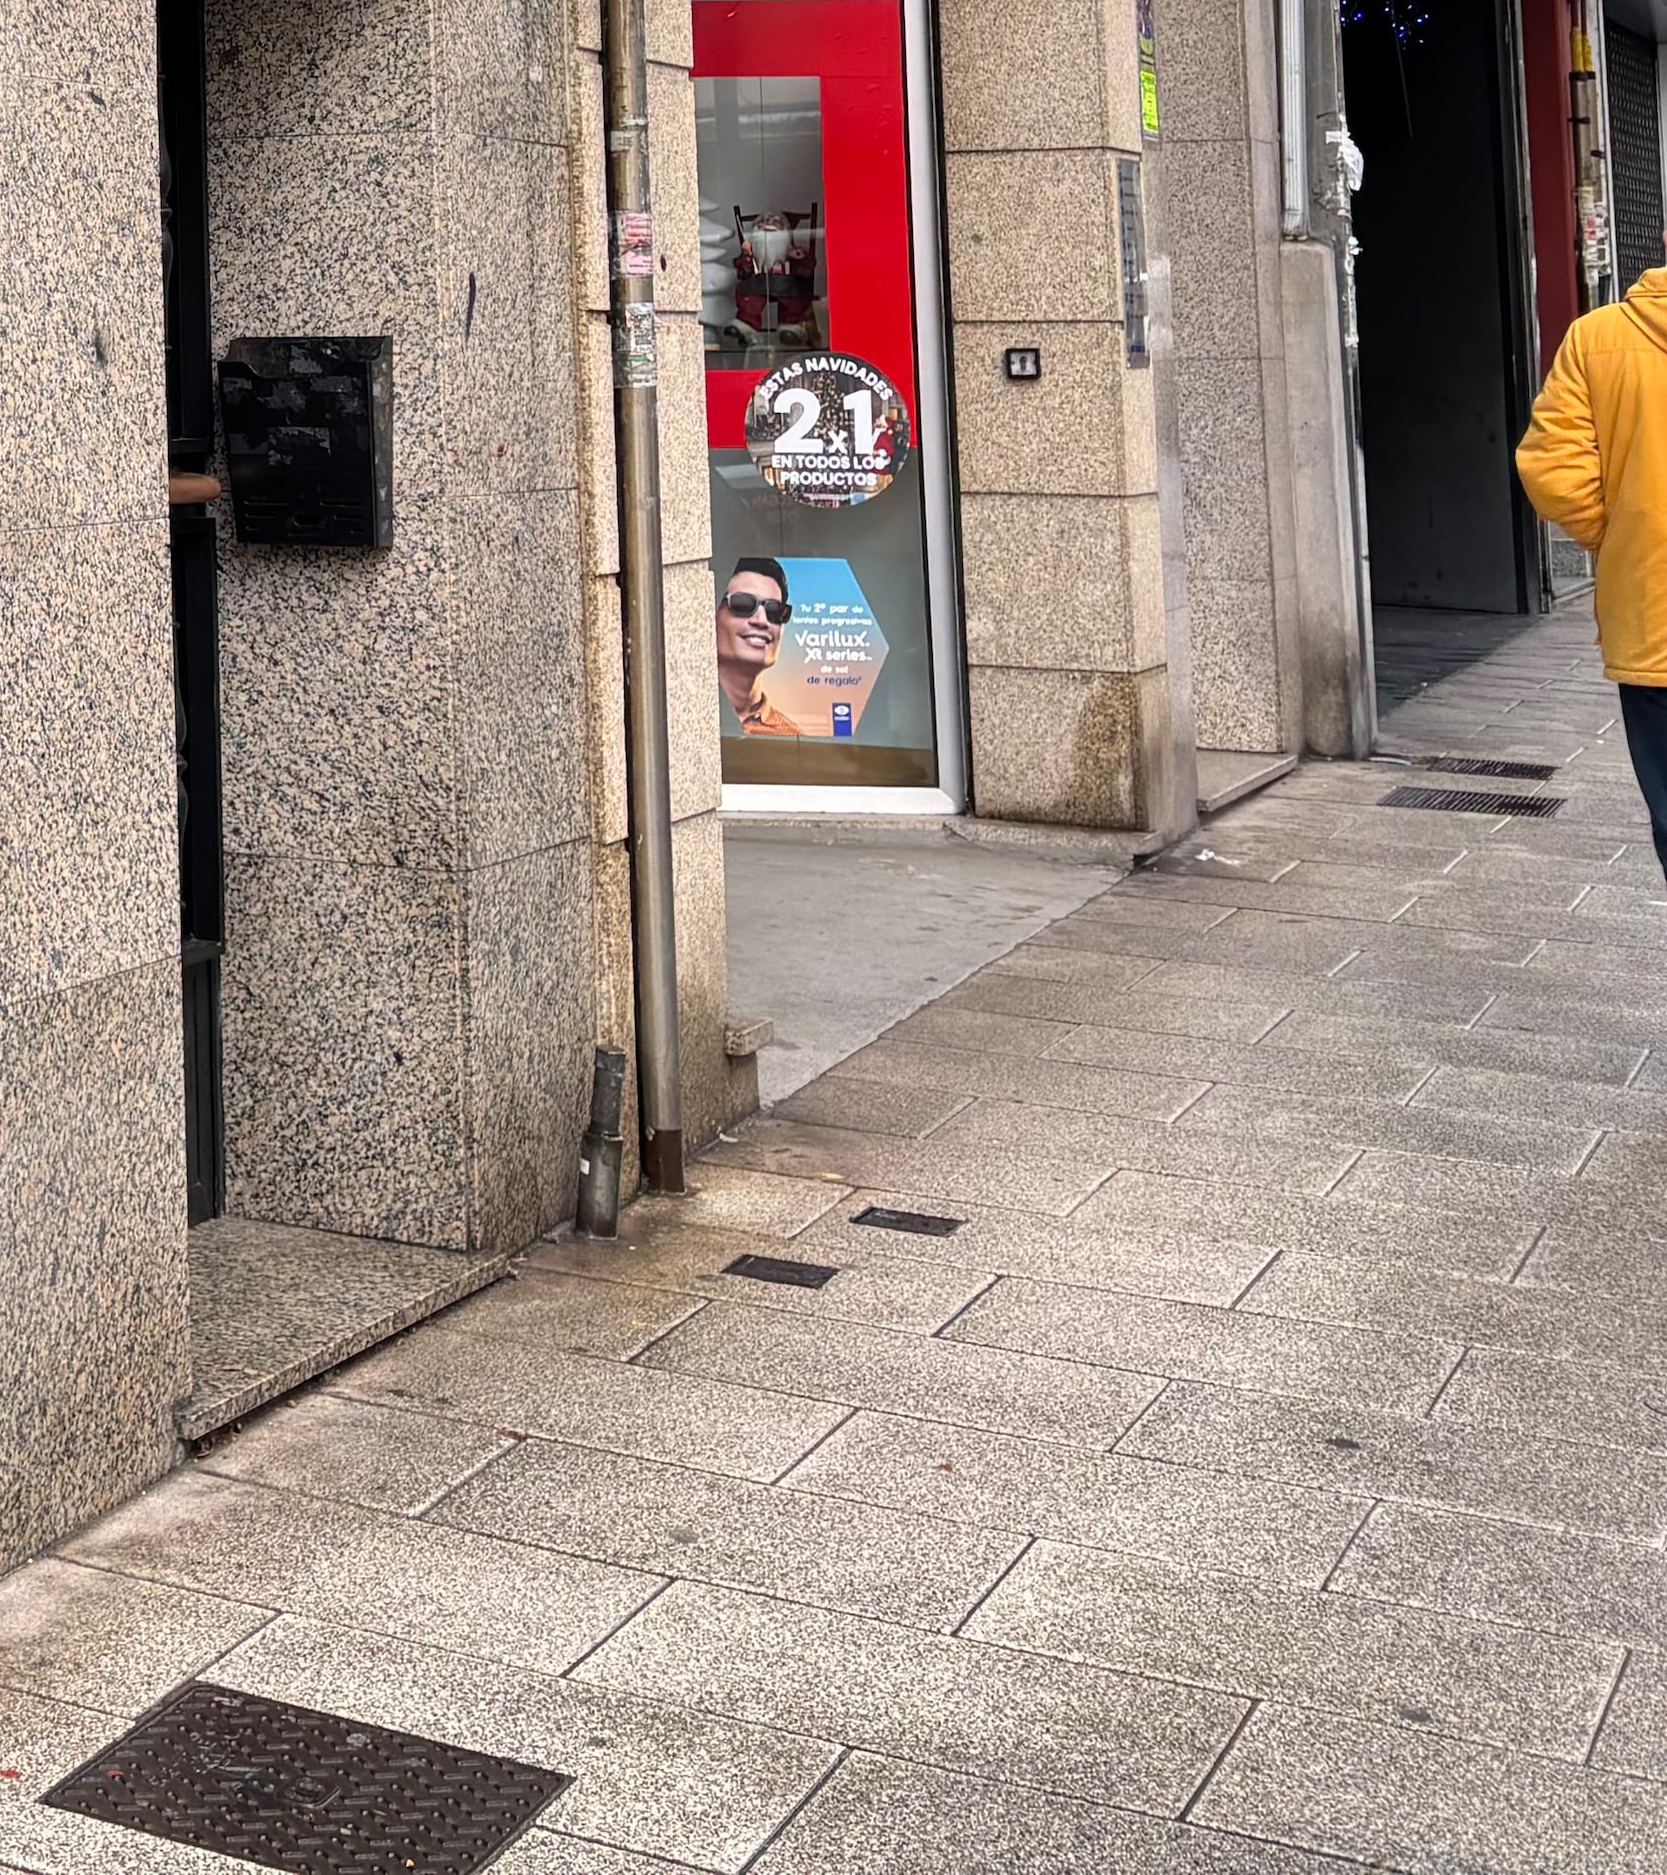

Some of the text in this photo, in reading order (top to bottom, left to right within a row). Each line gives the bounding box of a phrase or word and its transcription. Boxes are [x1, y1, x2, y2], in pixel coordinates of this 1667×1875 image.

[759, 356, 894, 401] ESTAS NAVIDADES
[771, 455, 885, 470] EN TODOS LOS
[780, 471, 878, 486] PRODUCTOS
[801, 604, 811, 613] Tu
[829, 605, 848, 616] par
[851, 605, 864, 614] de
[820, 666, 848, 674] de sol
[807, 676, 820, 685] de
